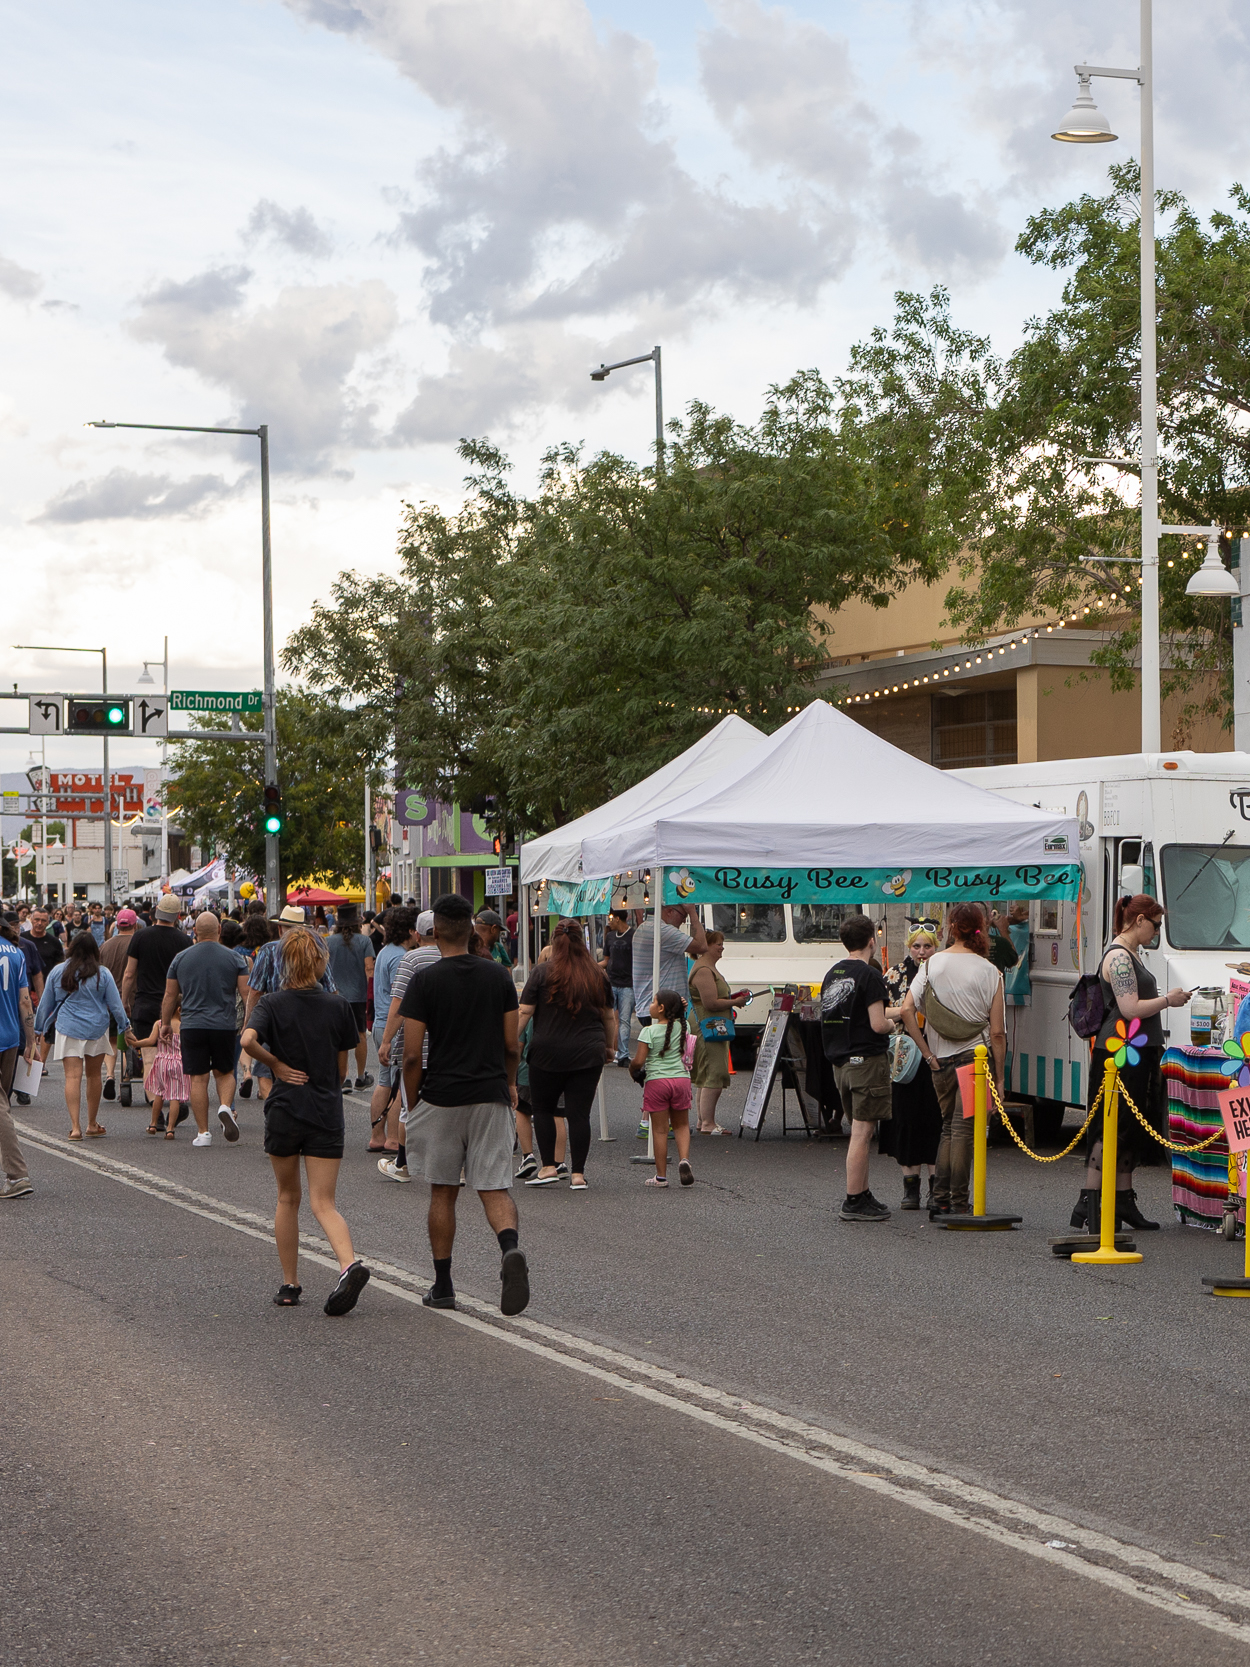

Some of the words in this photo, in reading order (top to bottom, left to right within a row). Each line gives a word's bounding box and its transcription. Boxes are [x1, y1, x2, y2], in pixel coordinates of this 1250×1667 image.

[172, 693, 243, 709] Richmond
[248, 694, 260, 705] Dr
[714, 867, 798, 899] Busy
[807, 868, 868, 889] Bee
[926, 867, 1007, 896] Busy
[1015, 865, 1074, 887] Bee
